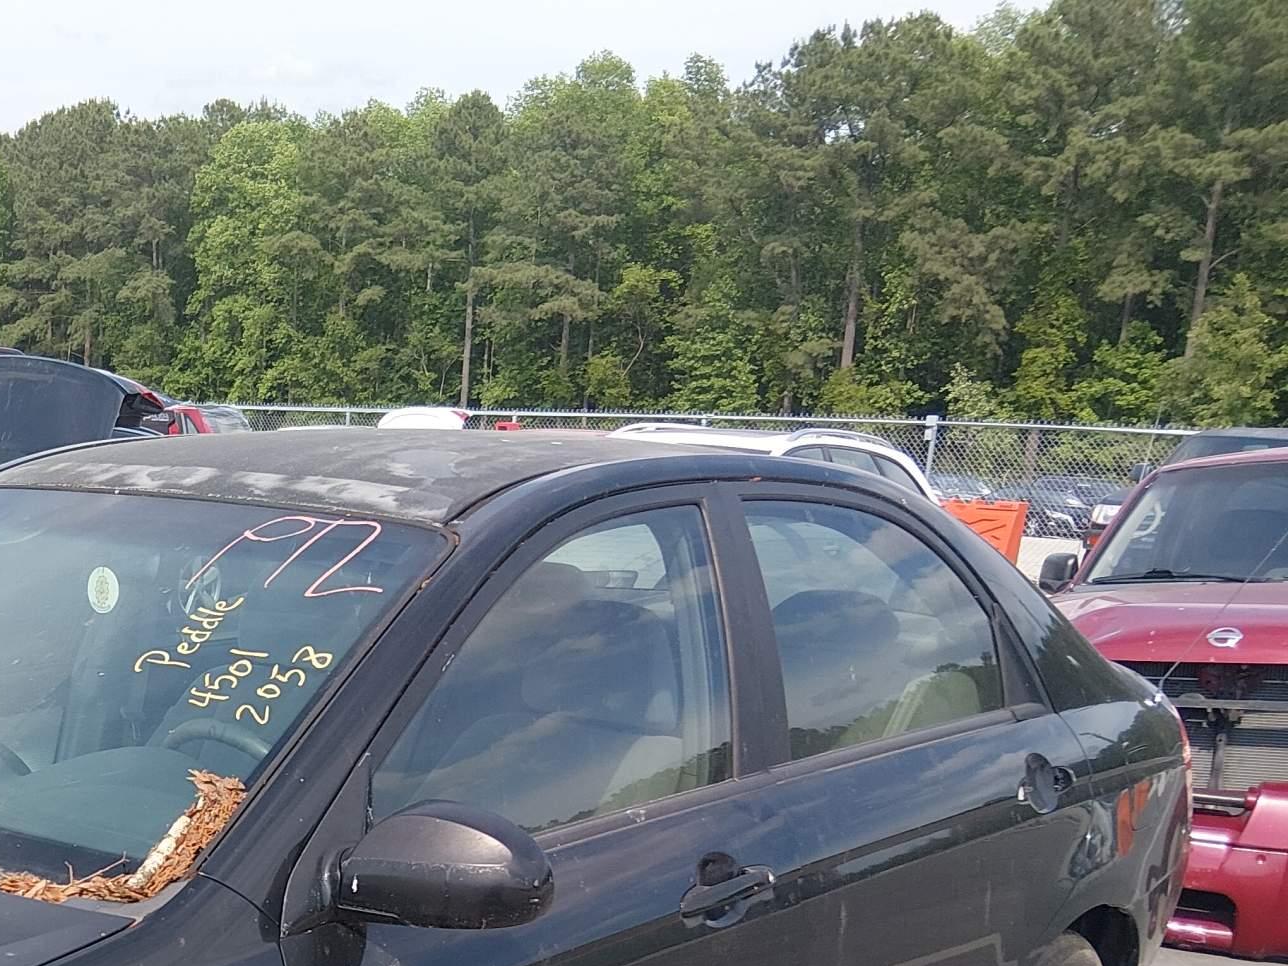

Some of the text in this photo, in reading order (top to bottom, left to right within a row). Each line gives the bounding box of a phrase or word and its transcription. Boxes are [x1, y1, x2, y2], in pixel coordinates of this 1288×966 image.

[134, 596, 244, 673] Peddle
[188, 648, 269, 707] 4501
[235, 645, 334, 724] 2058
